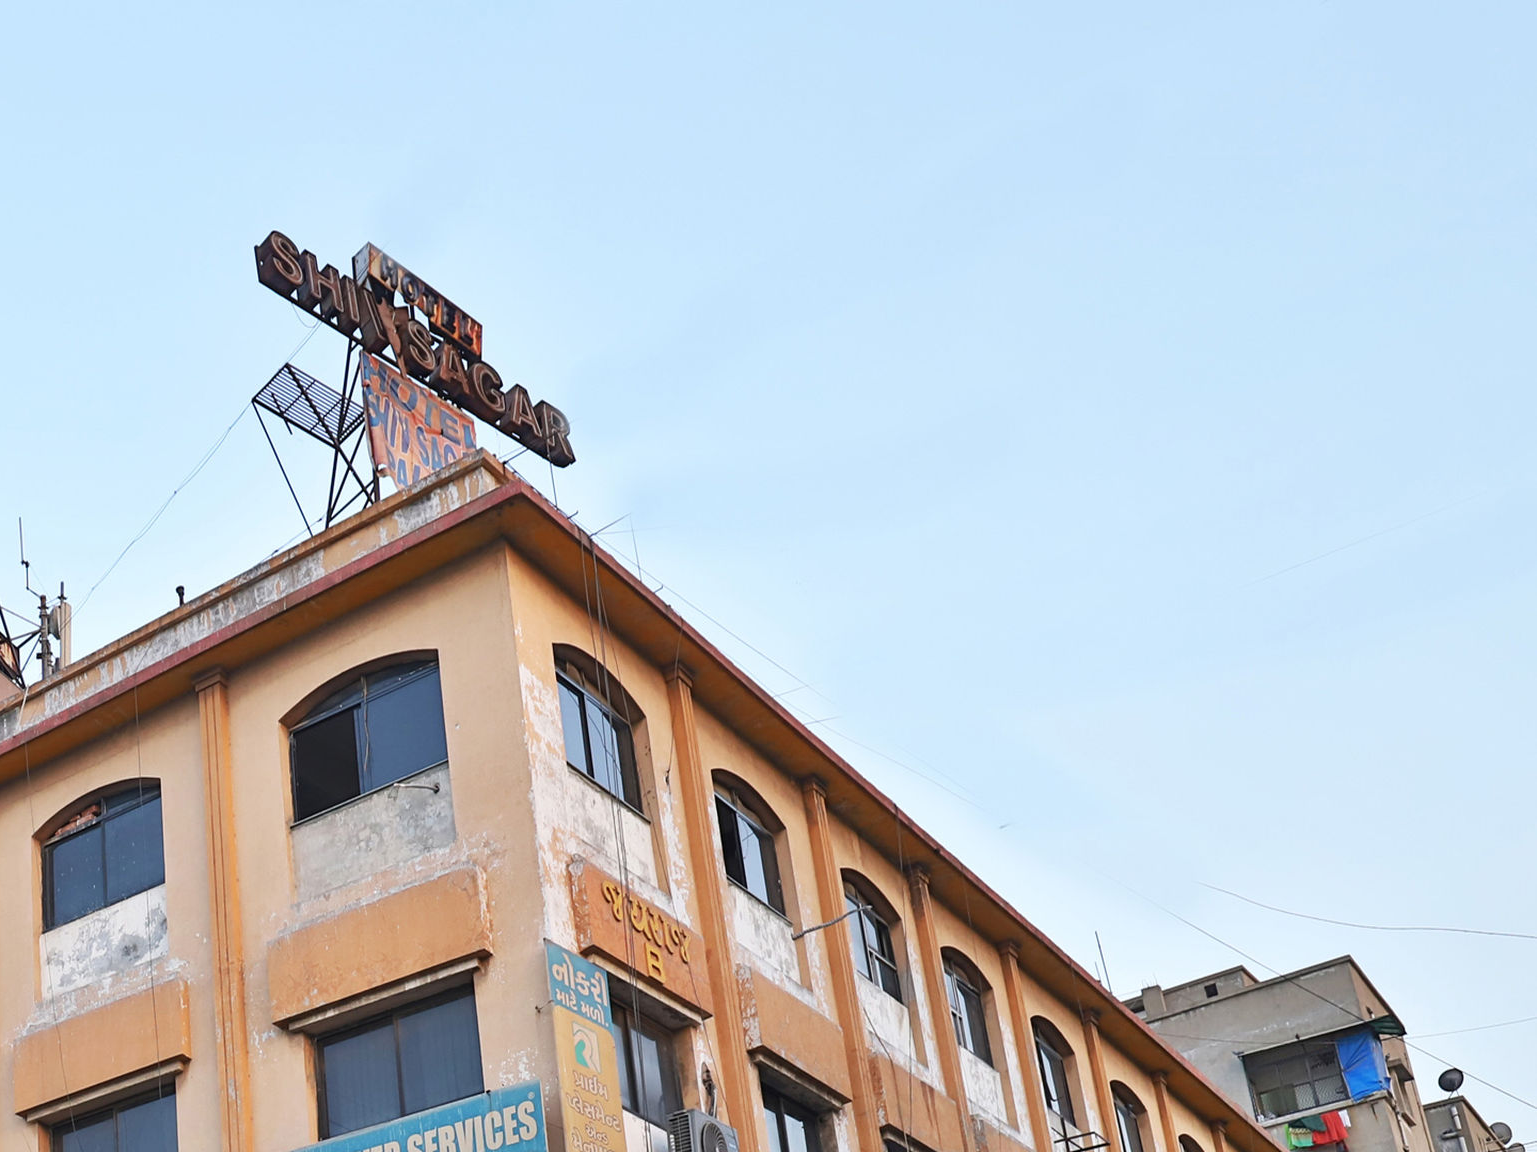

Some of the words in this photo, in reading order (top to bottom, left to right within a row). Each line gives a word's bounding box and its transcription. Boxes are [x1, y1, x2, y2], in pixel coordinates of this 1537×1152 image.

[362, 351, 477, 449] HOTEL
[403, 318, 574, 465] SAGAR
[645, 941, 666, 983] B
